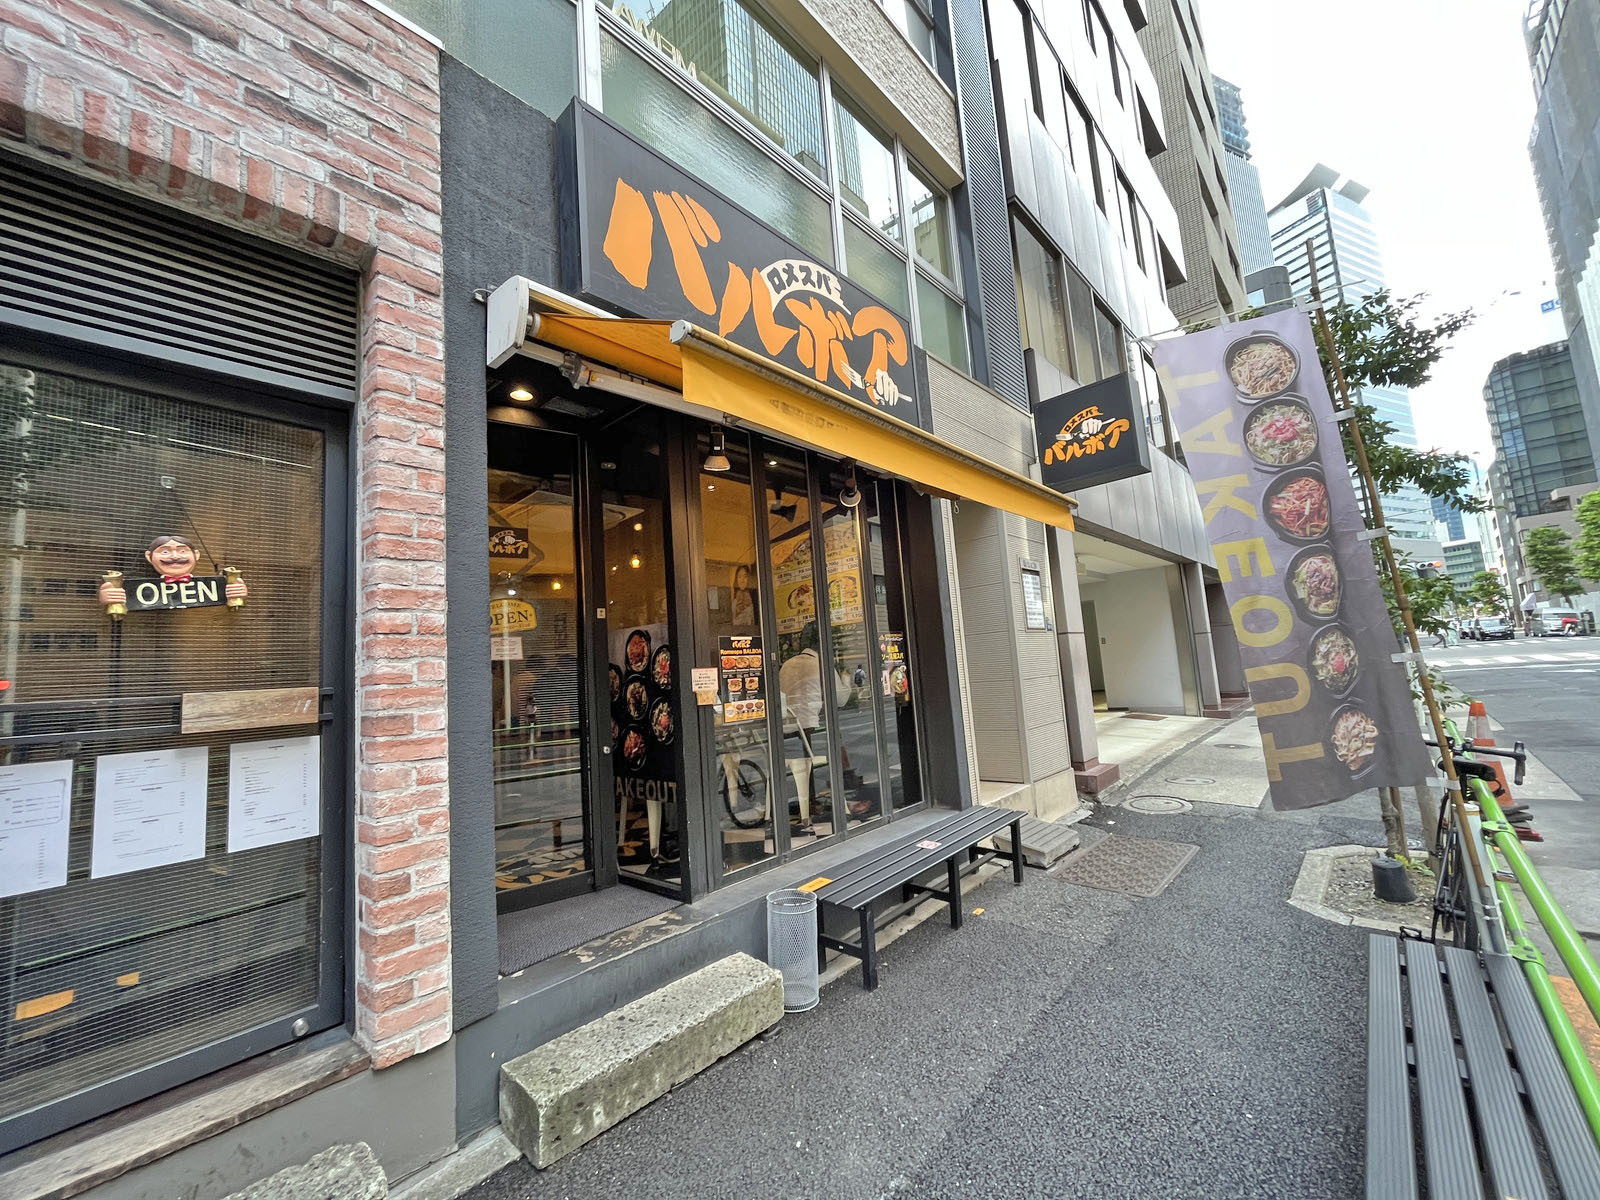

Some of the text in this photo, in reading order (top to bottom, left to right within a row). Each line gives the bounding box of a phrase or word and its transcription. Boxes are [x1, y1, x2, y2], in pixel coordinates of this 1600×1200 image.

[602, 177, 909, 405] バルボア
[1044, 418, 1130, 465] バルボア
[136, 580, 219, 605] OPEN
